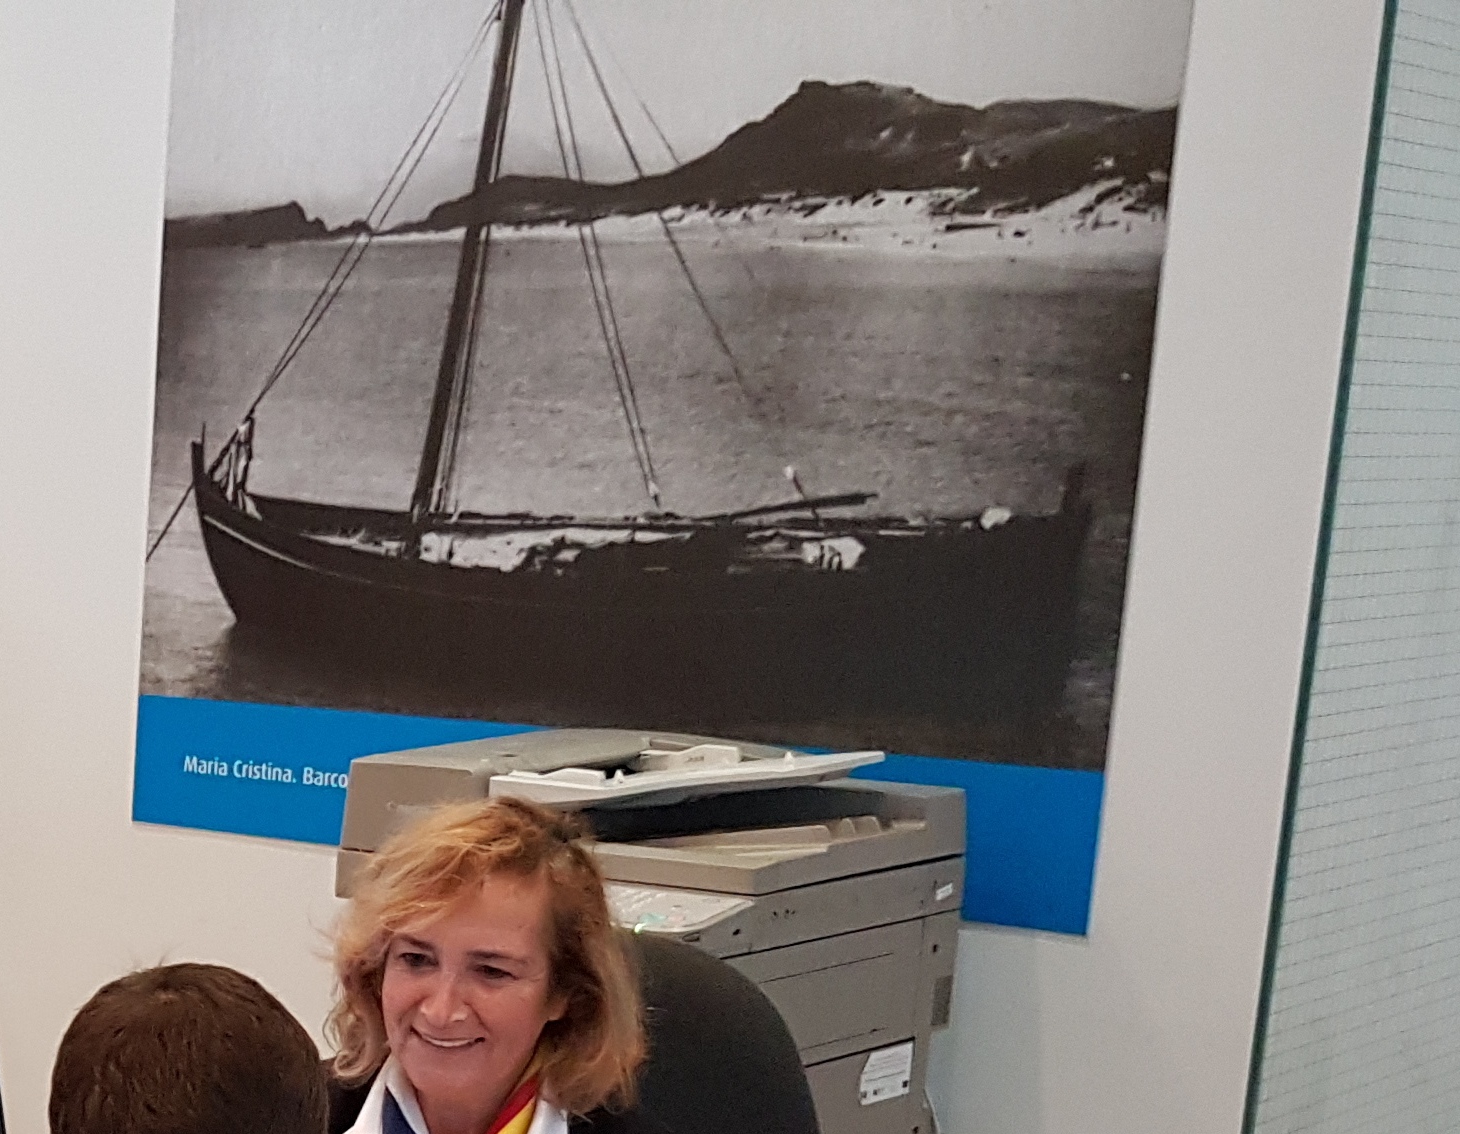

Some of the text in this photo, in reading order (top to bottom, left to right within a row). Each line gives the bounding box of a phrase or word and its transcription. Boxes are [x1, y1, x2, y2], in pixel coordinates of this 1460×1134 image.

[183, 755, 348, 788] Maria Cristina. Barco
